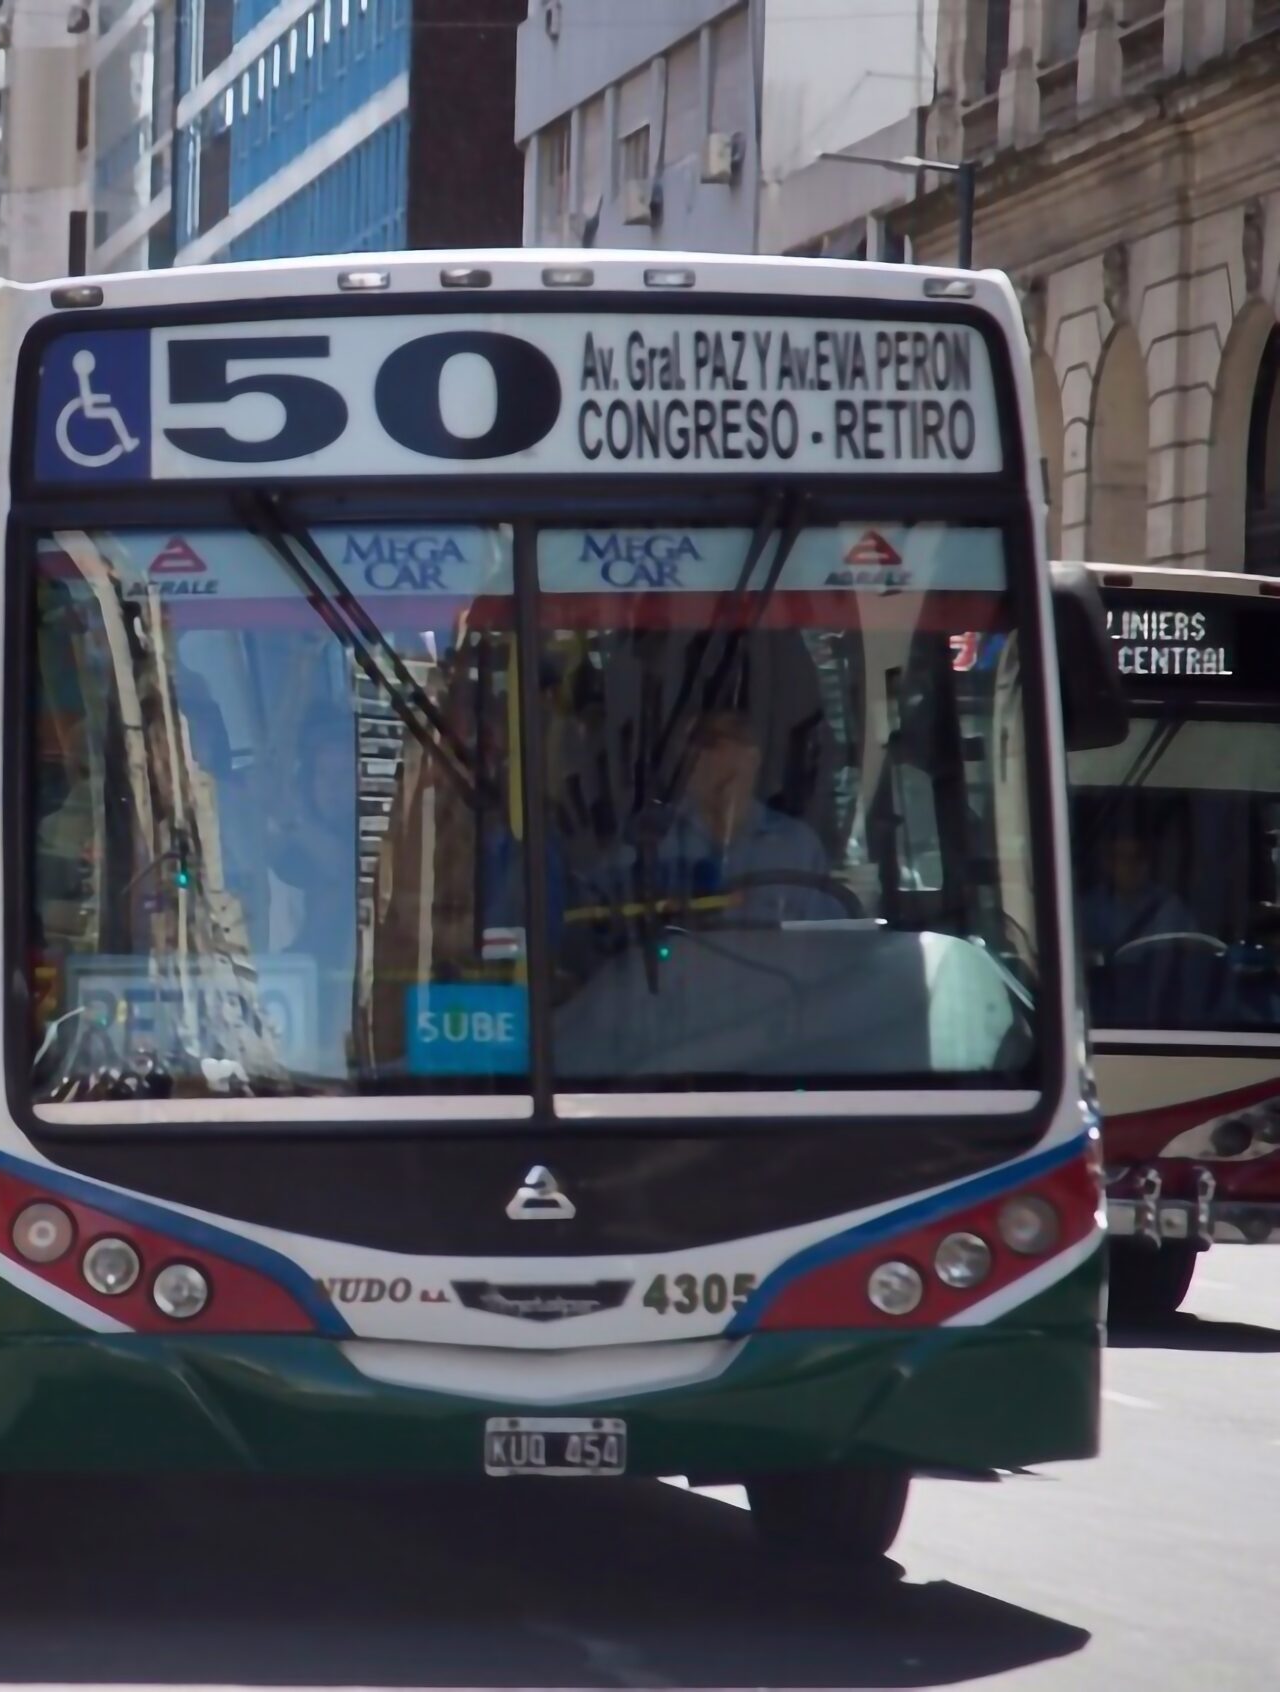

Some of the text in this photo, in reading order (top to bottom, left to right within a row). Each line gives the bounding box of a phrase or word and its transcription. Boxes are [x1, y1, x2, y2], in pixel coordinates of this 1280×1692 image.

[580, 331, 619, 391] Av.
[694, 331, 748, 391] PAZ
[753, 331, 772, 391] Y
[875, 331, 972, 391] PERON
[162, 331, 562, 463] 50
[578, 398, 799, 460] CONGRESO
[834, 399, 976, 460] RETIRO
[342, 532, 468, 564] MEGA
[578, 533, 703, 563] MEGA
[363, 559, 449, 590] CAR
[600, 559, 685, 588] CAR
[1117, 646, 1233, 675] CENTRAL
[417, 1010, 517, 1044] SUBE
[641, 1272, 756, 1315] 4305
[565, 1433, 619, 1466] 454
